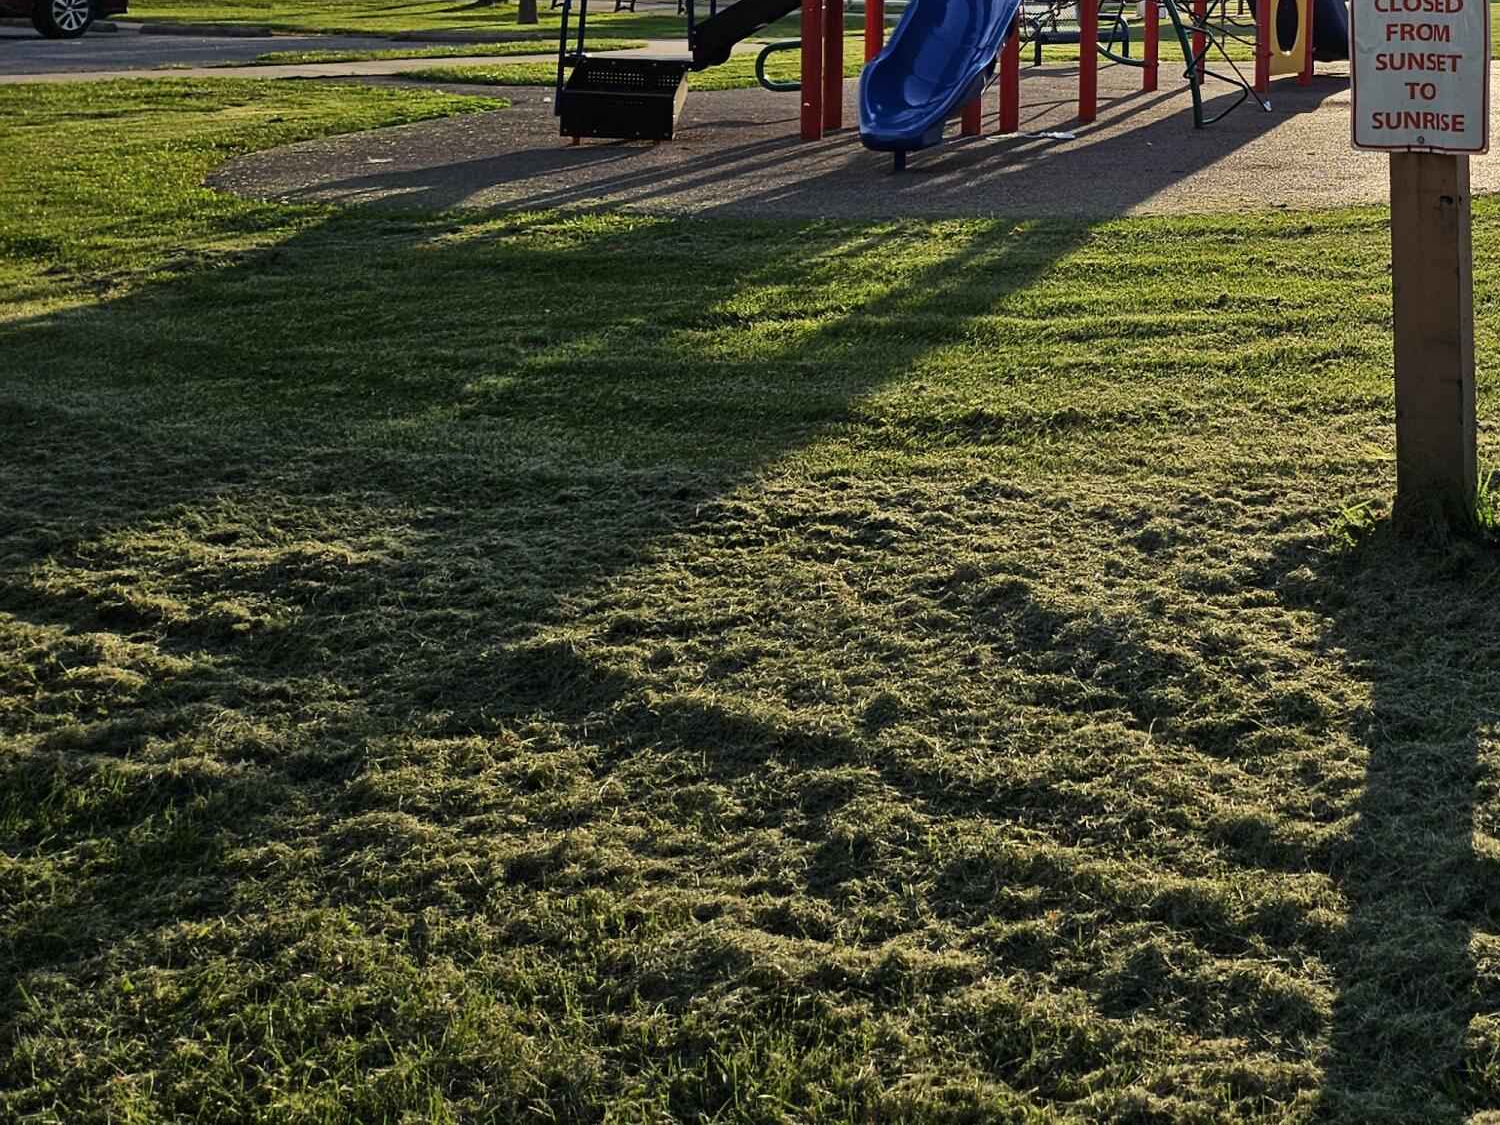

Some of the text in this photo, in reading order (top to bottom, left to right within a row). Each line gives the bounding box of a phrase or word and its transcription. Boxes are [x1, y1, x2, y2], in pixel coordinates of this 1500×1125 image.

[1386, 24, 1450, 42] FROM
[1375, 53, 1462, 72] SUNSET
[1404, 82, 1437, 100] TO
[1371, 112, 1465, 132] SUNRISE
